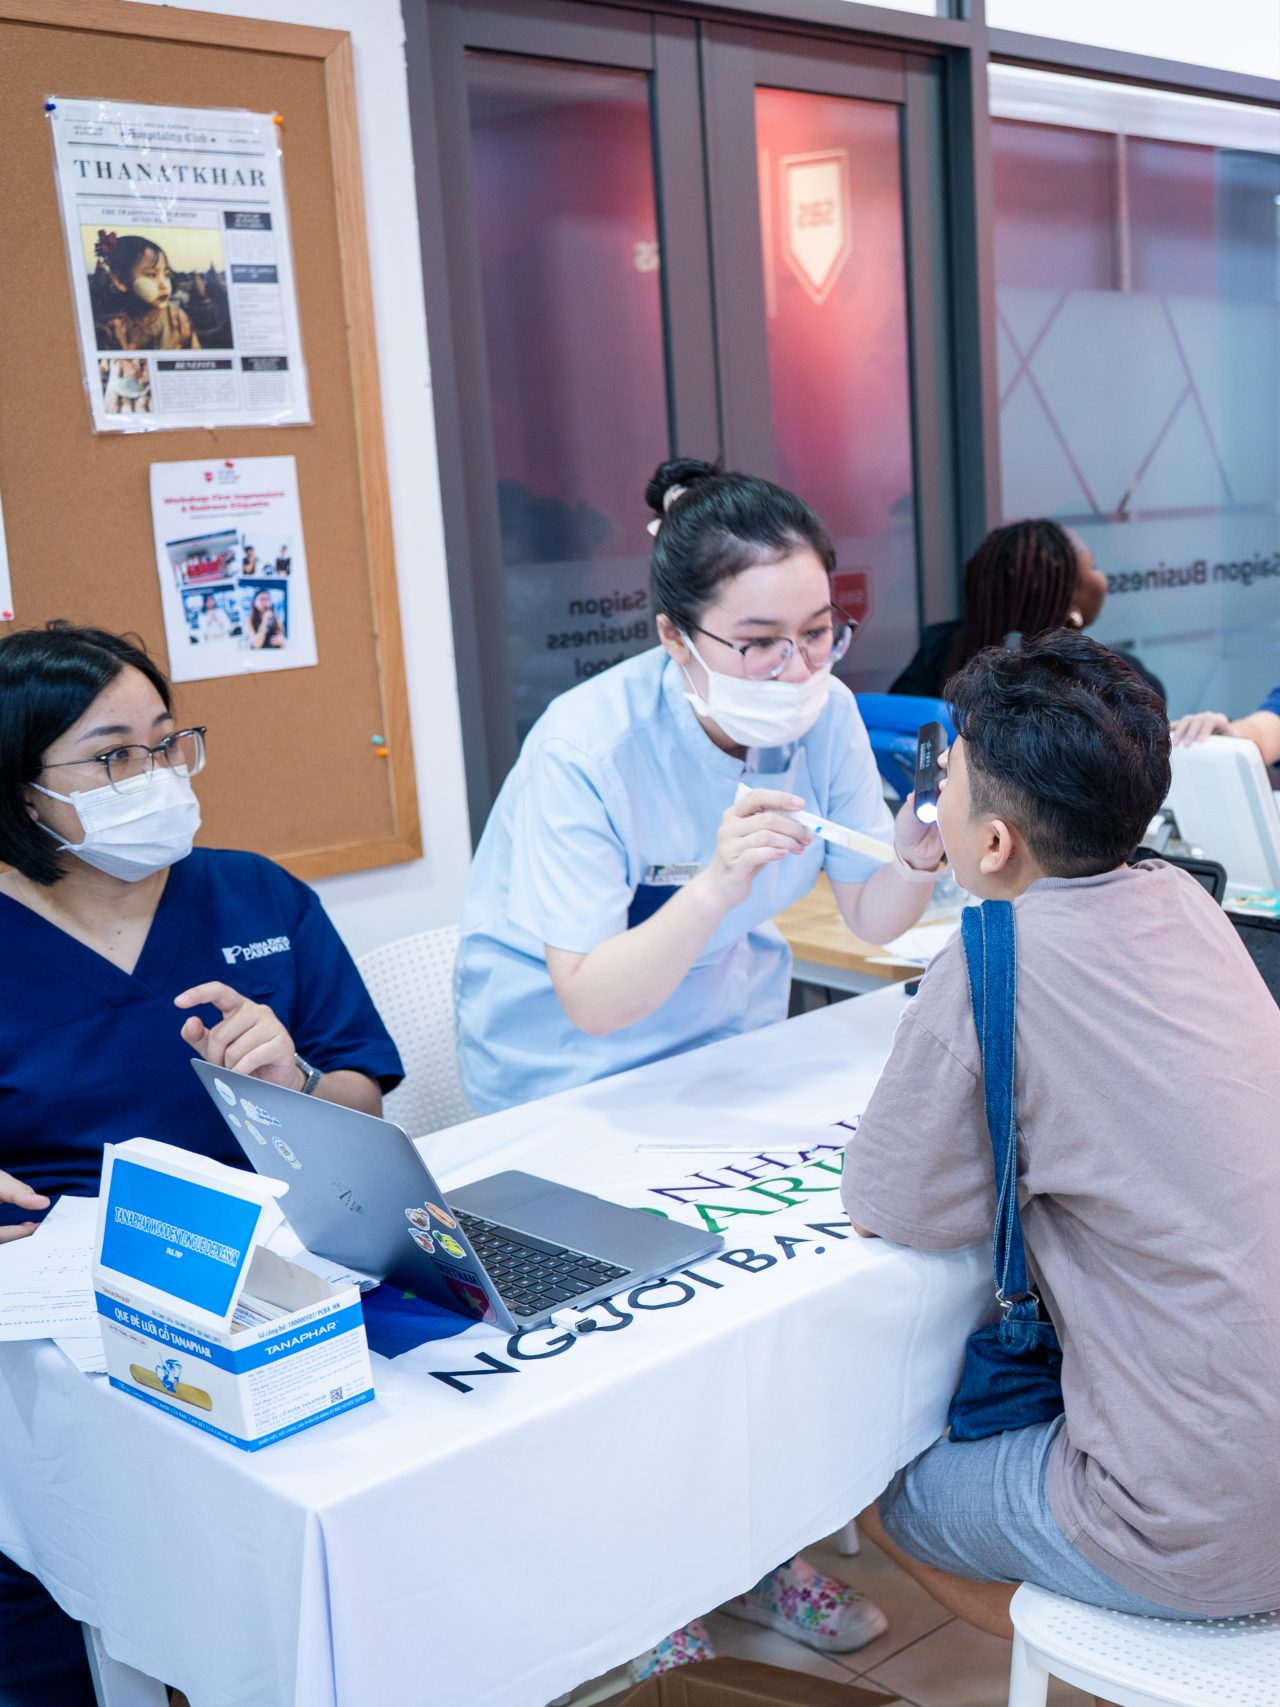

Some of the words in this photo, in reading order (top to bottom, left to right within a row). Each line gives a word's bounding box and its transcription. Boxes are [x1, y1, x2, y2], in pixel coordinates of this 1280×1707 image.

[73, 159, 266, 187] THANATKHAR
[242, 941, 291, 961] PARKWAY
[115, 1206, 150, 1233] TANAPHAR
[149, 1218, 180, 1244] WOODEN
[179, 1228, 205, 1253] TONGUE
[203, 1238, 240, 1268] DEPRESSOR
[439, 1261, 481, 1287] VIETNAM
[102, 1286, 131, 1304] TANAPHAR
[115, 1308, 130, 1321] QUE
[130, 1314, 141, 1328] ĐÈ
[141, 1320, 158, 1336] LƯỠI
[158, 1324, 170, 1341] GỖ
[170, 1333, 212, 1359] TANAPHAR
[266, 1327, 279, 1337] công
[332, 1302, 341, 1310] HN
[264, 1321, 337, 1355] TANAPHAR
[302, 1394, 327, 1407] TANAPHAR
